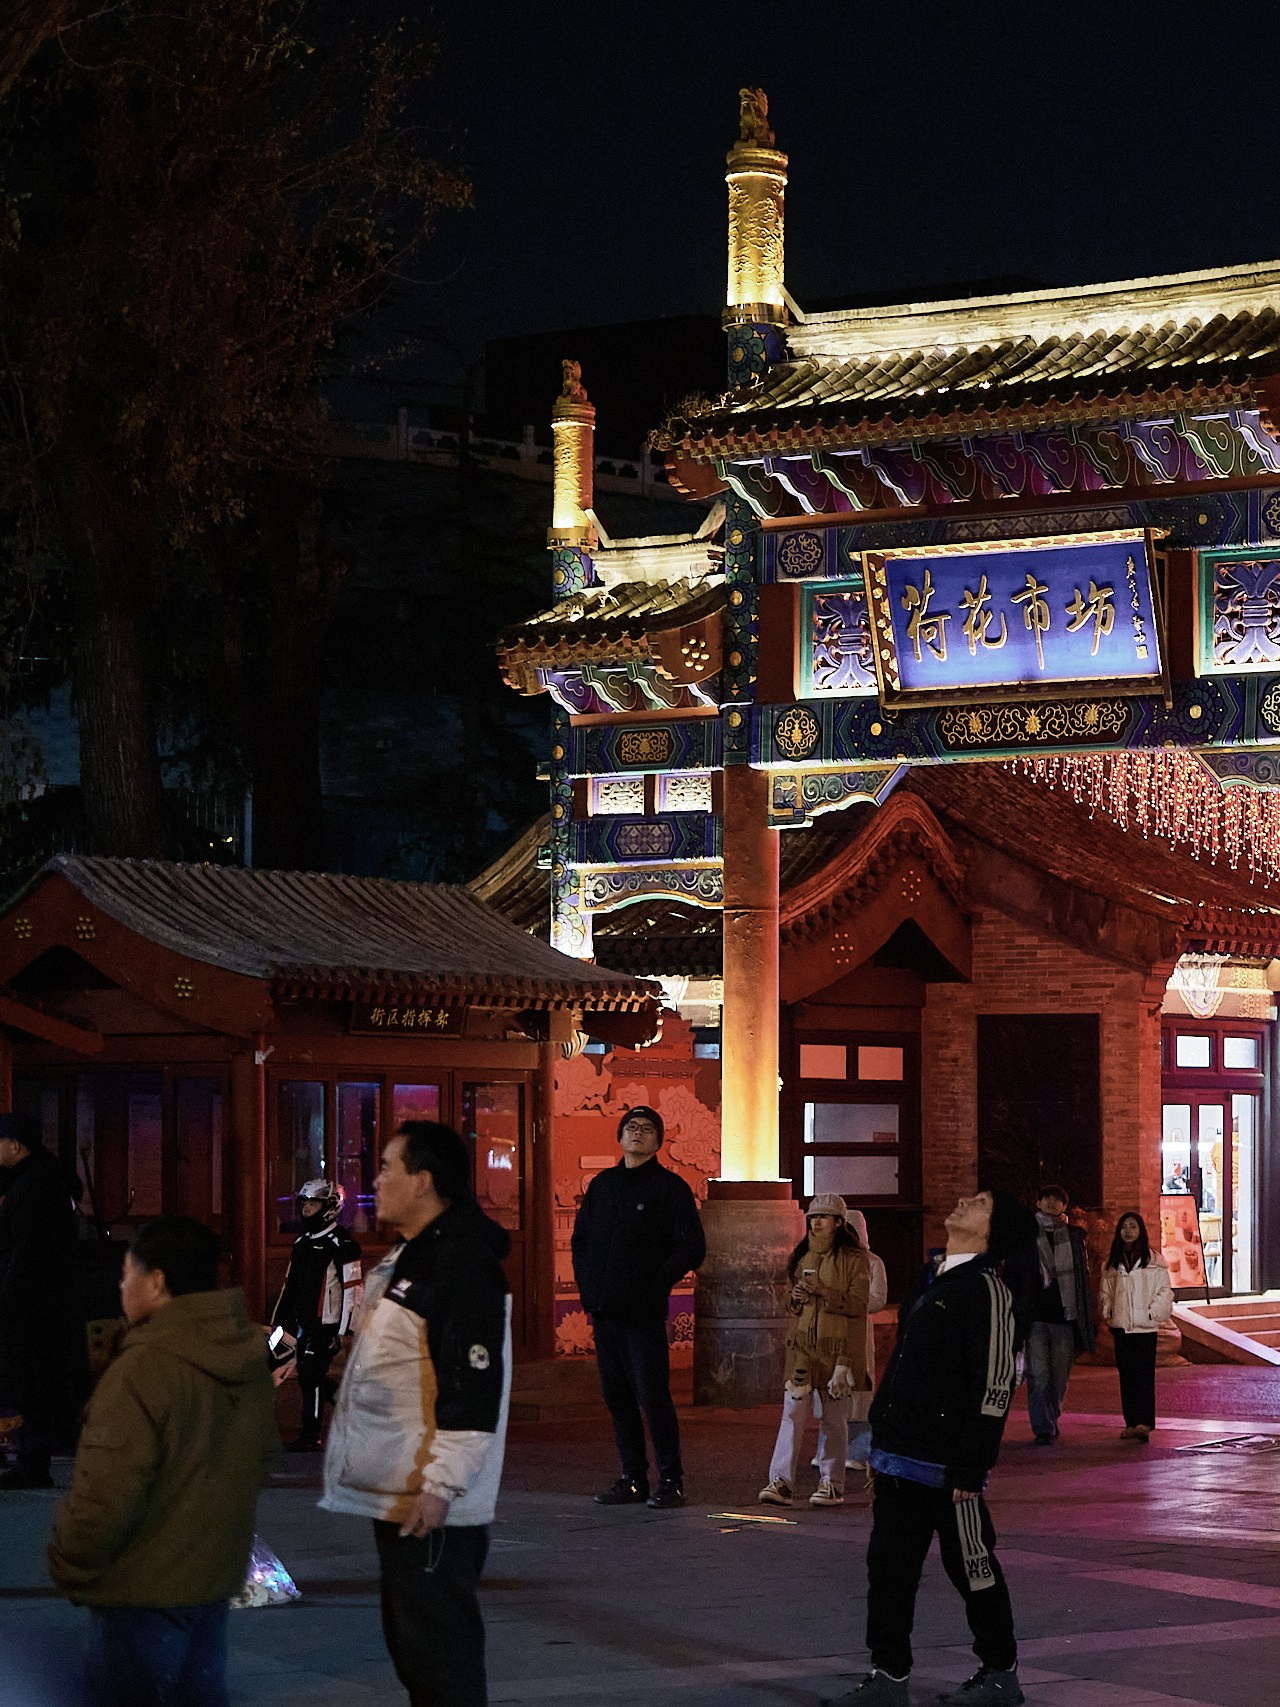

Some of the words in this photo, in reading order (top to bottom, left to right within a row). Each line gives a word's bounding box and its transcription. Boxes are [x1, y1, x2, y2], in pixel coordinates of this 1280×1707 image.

[901, 569, 1115, 671] 荷花市场
[370, 1007, 450, 1029] 街区指挥部
